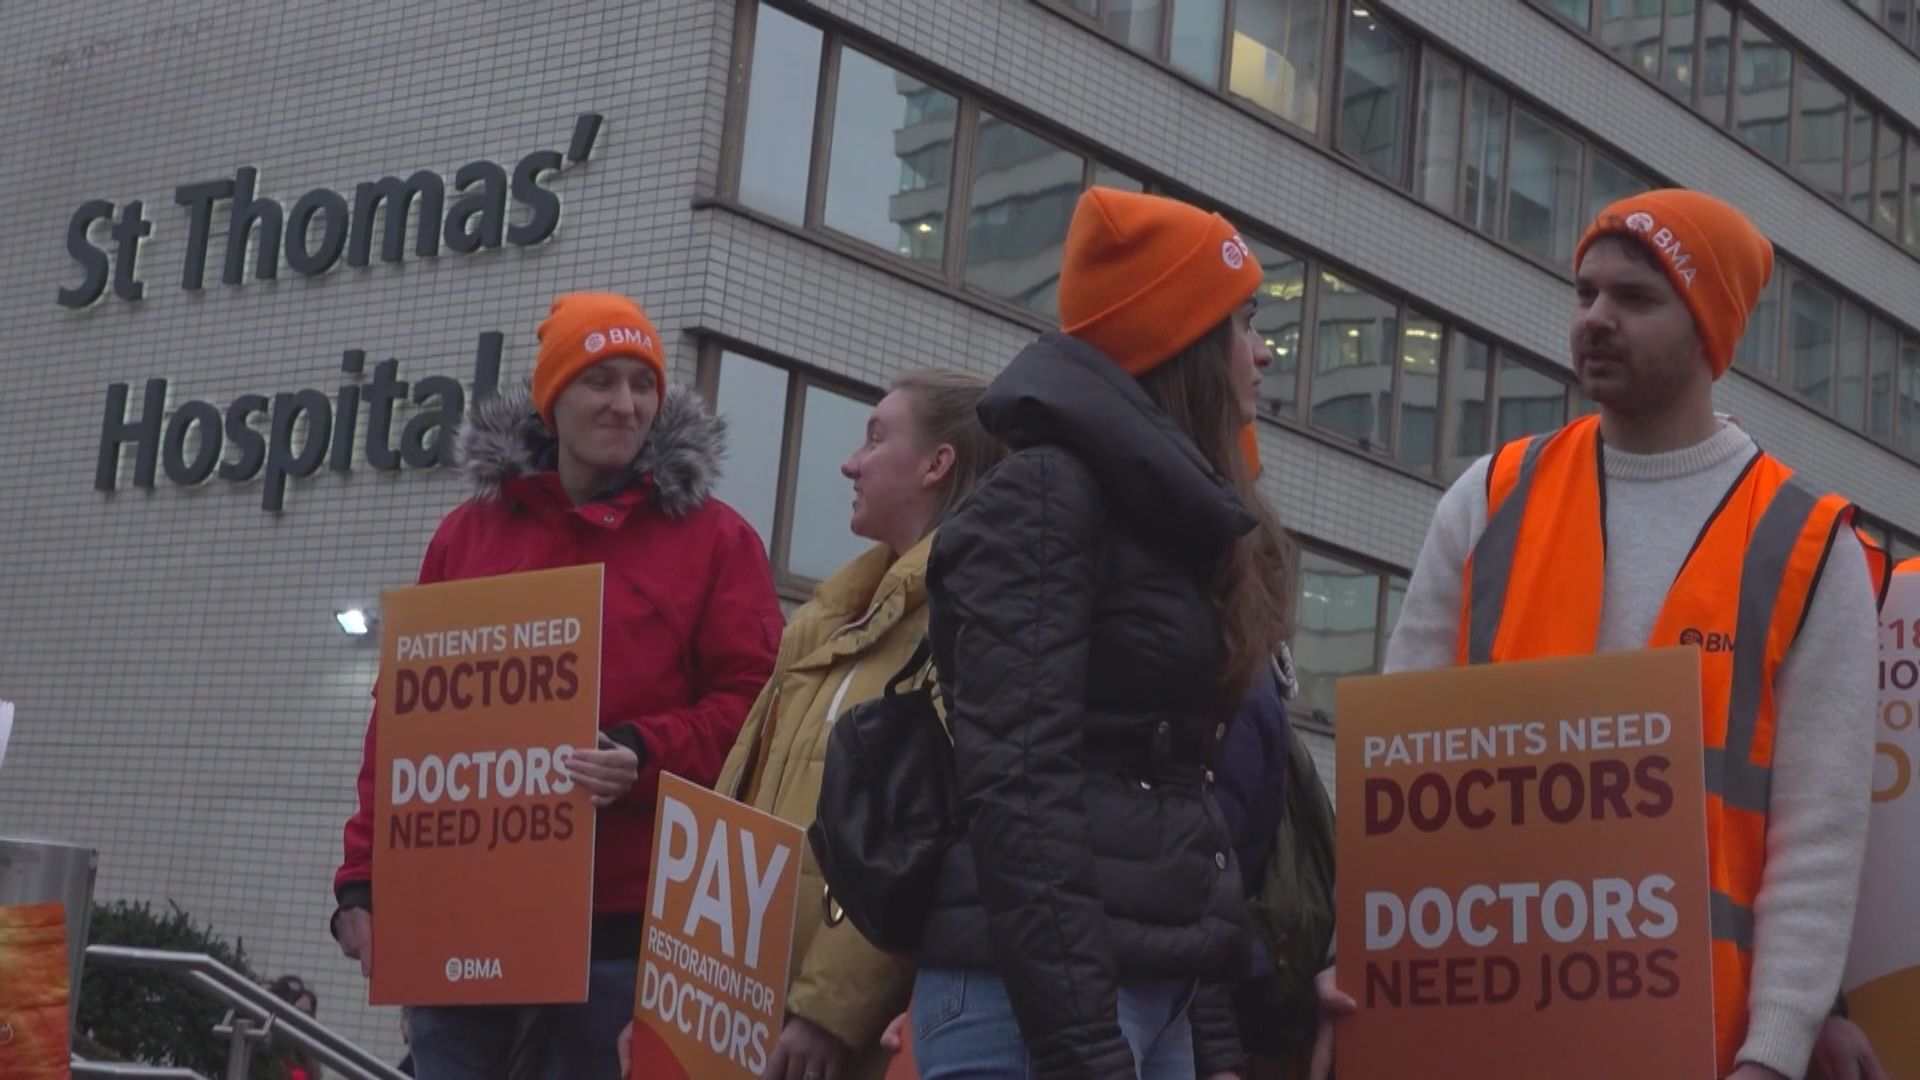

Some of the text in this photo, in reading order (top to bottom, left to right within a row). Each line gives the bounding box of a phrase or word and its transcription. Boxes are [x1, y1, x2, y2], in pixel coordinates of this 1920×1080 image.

[57, 113, 602, 309] St Thomas'
[1653, 227, 1697, 288] BMA
[608, 327, 654, 351] BMA
[396, 617, 581, 662] PATIENTS NEED
[395, 651, 579, 715] DOCTORS
[1363, 712, 1672, 769] PATIENTS NEED
[390, 744, 577, 806] DOCTORS
[1364, 755, 1674, 836] DOCTORS
[390, 801, 574, 852] NEED JOBS
[651, 795, 791, 970] PAY
[1364, 874, 1679, 951] DOCTORS
[464, 957, 503, 980] BMA
[648, 925, 775, 1016] RESTORATION FOR
[1364, 948, 1681, 1012] NEED JOBS
[640, 960, 770, 1076] DOCTORS
